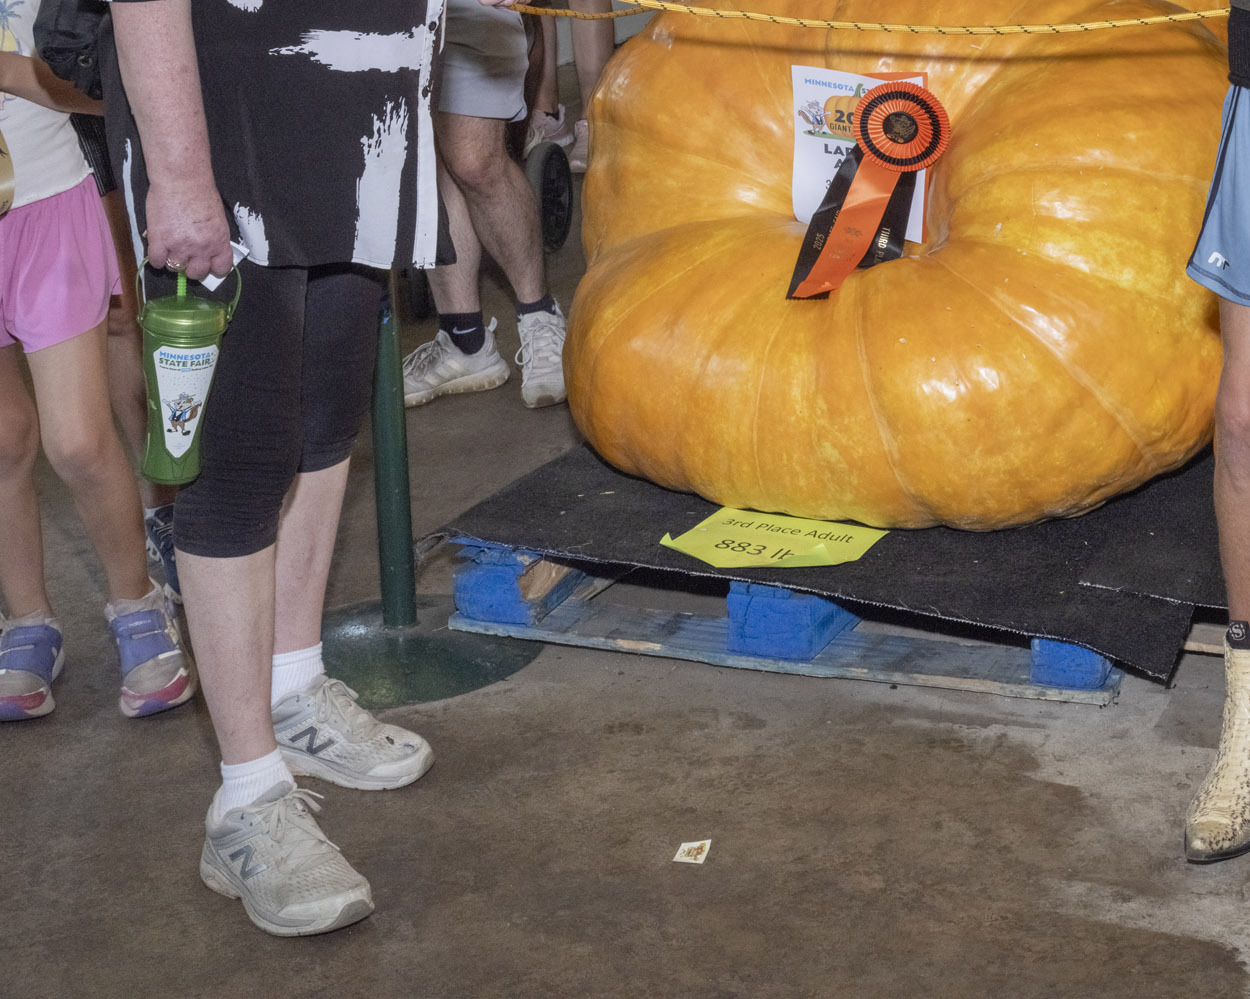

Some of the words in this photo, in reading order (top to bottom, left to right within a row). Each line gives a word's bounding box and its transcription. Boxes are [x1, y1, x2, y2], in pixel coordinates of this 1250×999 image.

[804, 78, 855, 92] MINNESOTA
[829, 123, 851, 133] GIANT
[812, 232, 825, 250] 2025
[877, 227, 891, 249] THIRD
[159, 357, 188, 367] STATE
[190, 358, 211, 367] FAIR
[160, 351, 211, 361] MINNESOTA
[721, 518, 752, 530] 3rd
[755, 522, 802, 536] Place
[804, 529, 855, 544] Adult
[713, 538, 767, 556] 883
